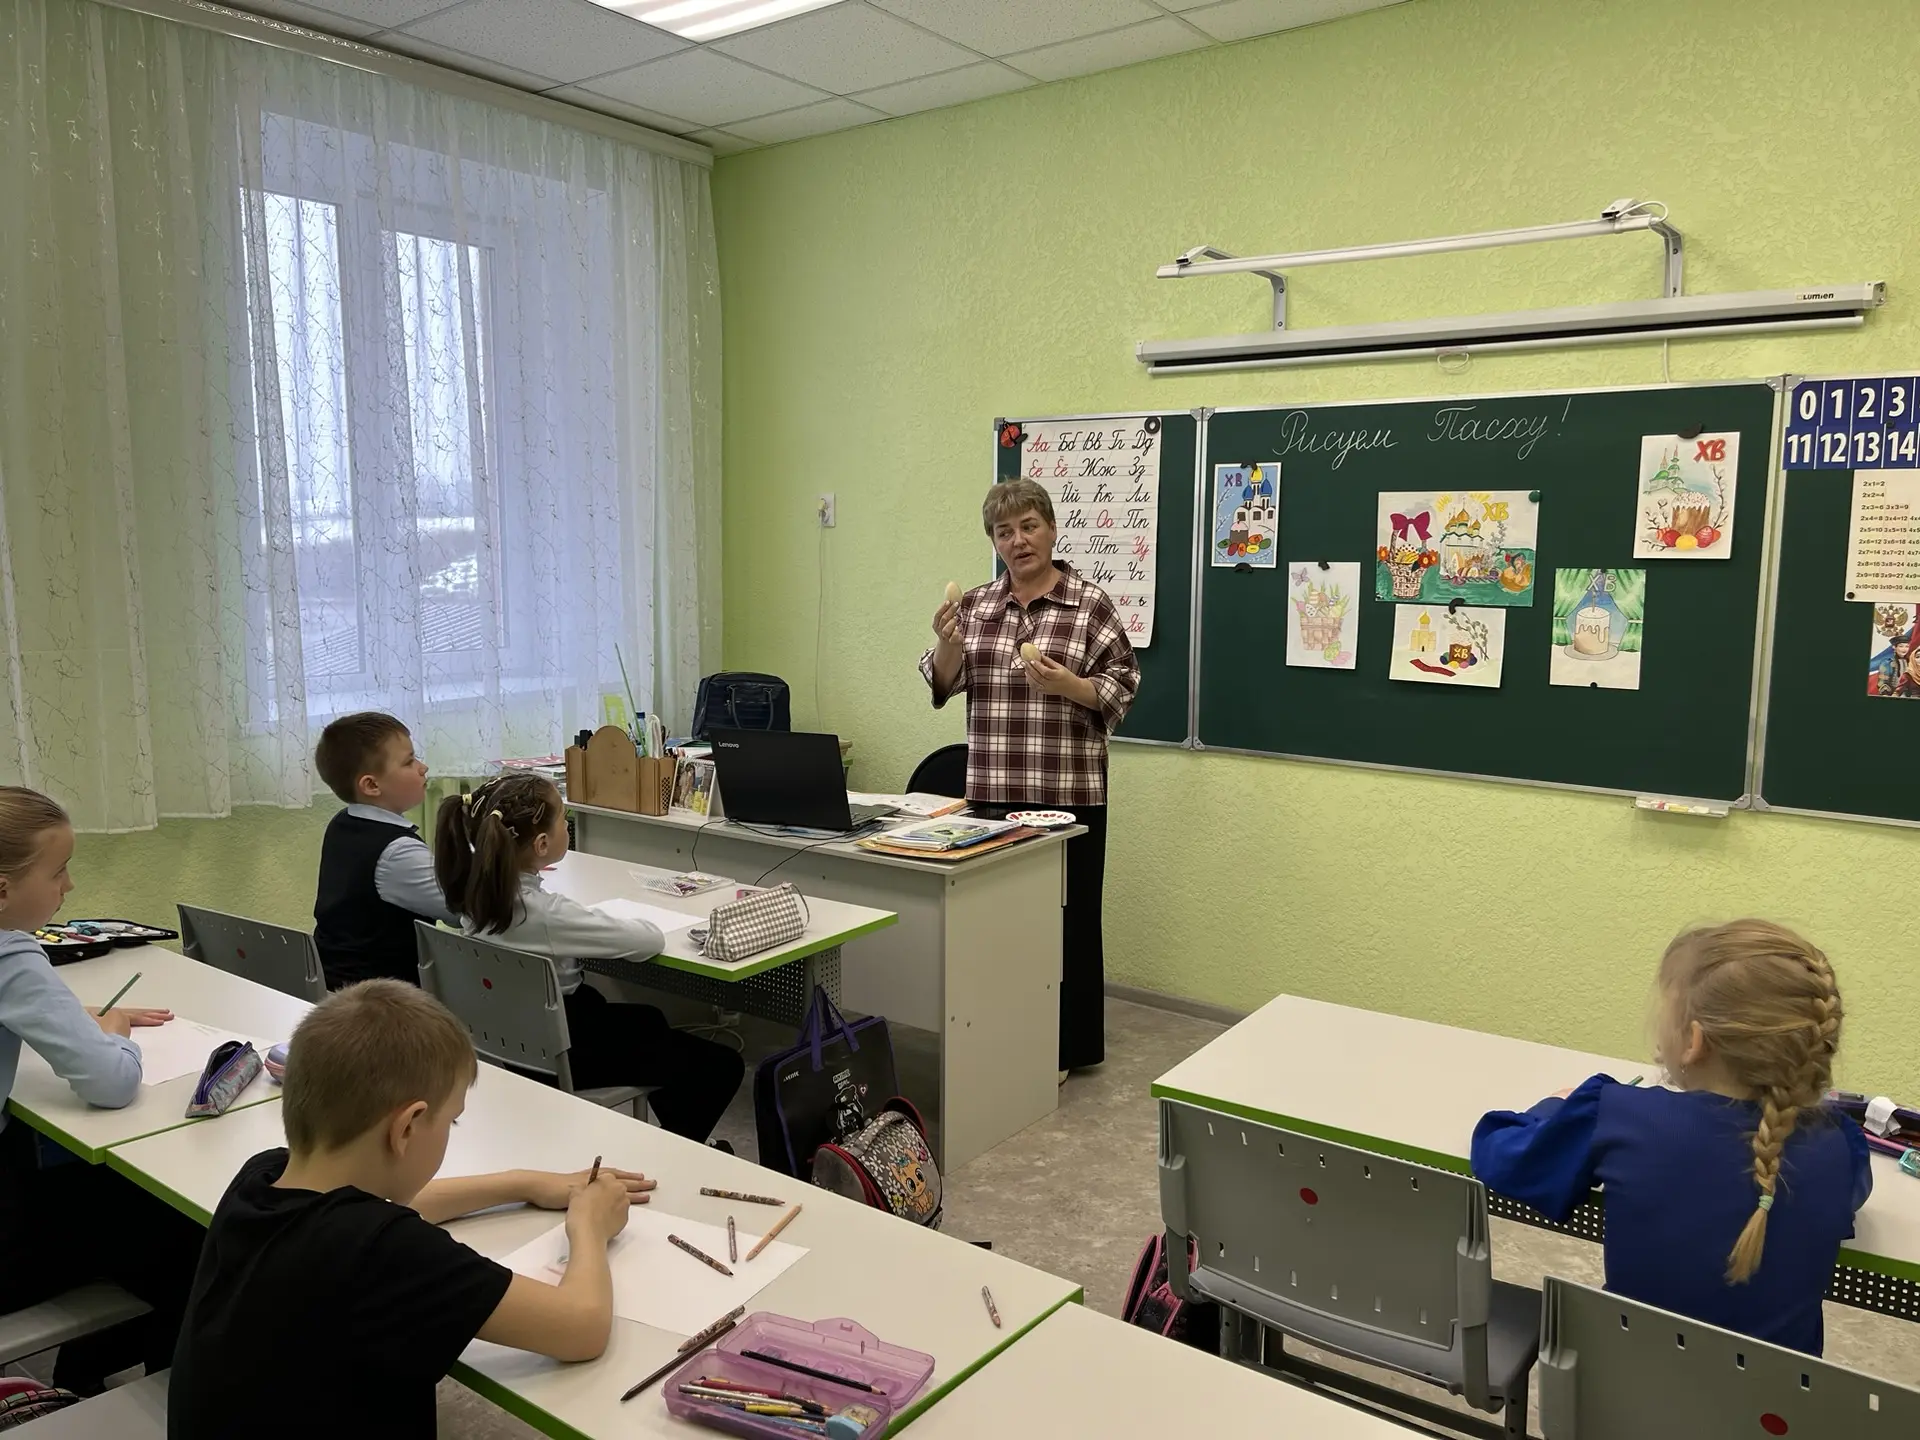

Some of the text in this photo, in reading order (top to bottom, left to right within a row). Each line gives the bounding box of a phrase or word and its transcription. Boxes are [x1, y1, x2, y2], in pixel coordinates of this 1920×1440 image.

[1799, 386, 1905, 420] 0 1 2 3
[1027, 434, 1050, 452] Аа
[1058, 431, 1083, 452] Бб
[1083, 431, 1103, 451] Вв
[1108, 429, 1126, 450] Гг
[1272, 410, 1399, 471] Рисуем
[1787, 431, 1916, 464] 11 12 13 14
[1029, 455, 1146, 483] Ее Ёё Жж Зз
[1061, 481, 1150, 503] Йй Кк Лл
[1065, 508, 1150, 529] Нн Оо Пп
[1056, 534, 1150, 561] Сс Тт Уу
[1092, 560, 1116, 584] Цц
[1128, 561, 1145, 580] Чч
[1124, 613, 1145, 632] Яя
[718, 741, 740, 749] Lenovo
